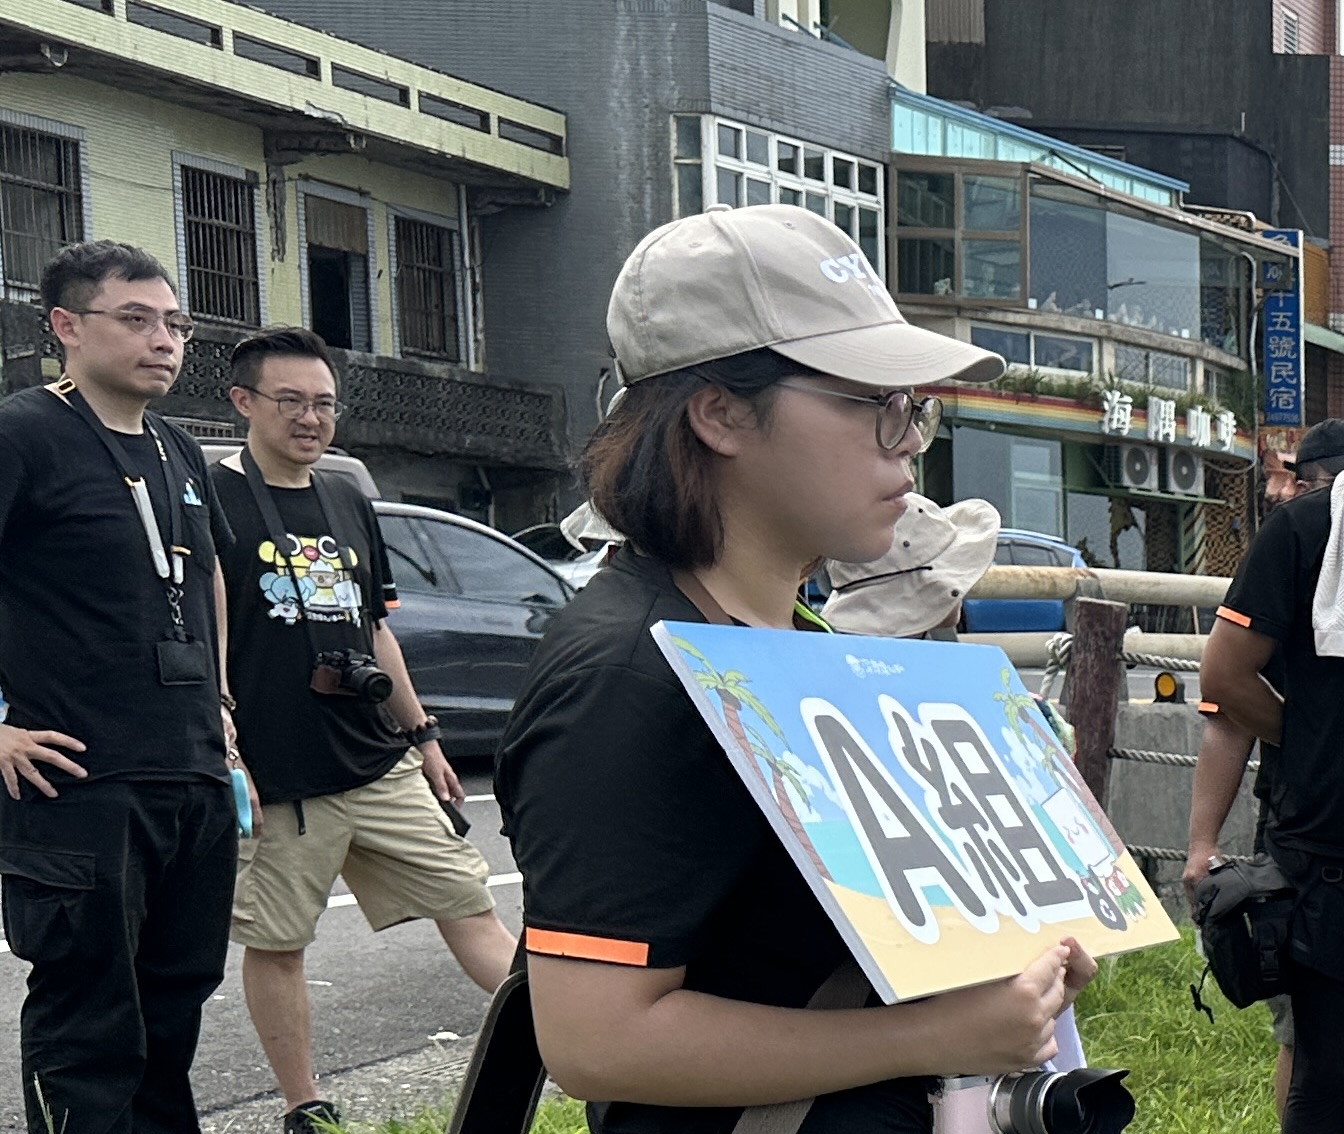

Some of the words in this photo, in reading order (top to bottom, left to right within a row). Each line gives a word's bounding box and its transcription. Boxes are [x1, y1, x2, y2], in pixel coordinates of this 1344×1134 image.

[1101, 390, 1237, 451] 海隅咖啡
[813, 711, 1084, 928] A組
